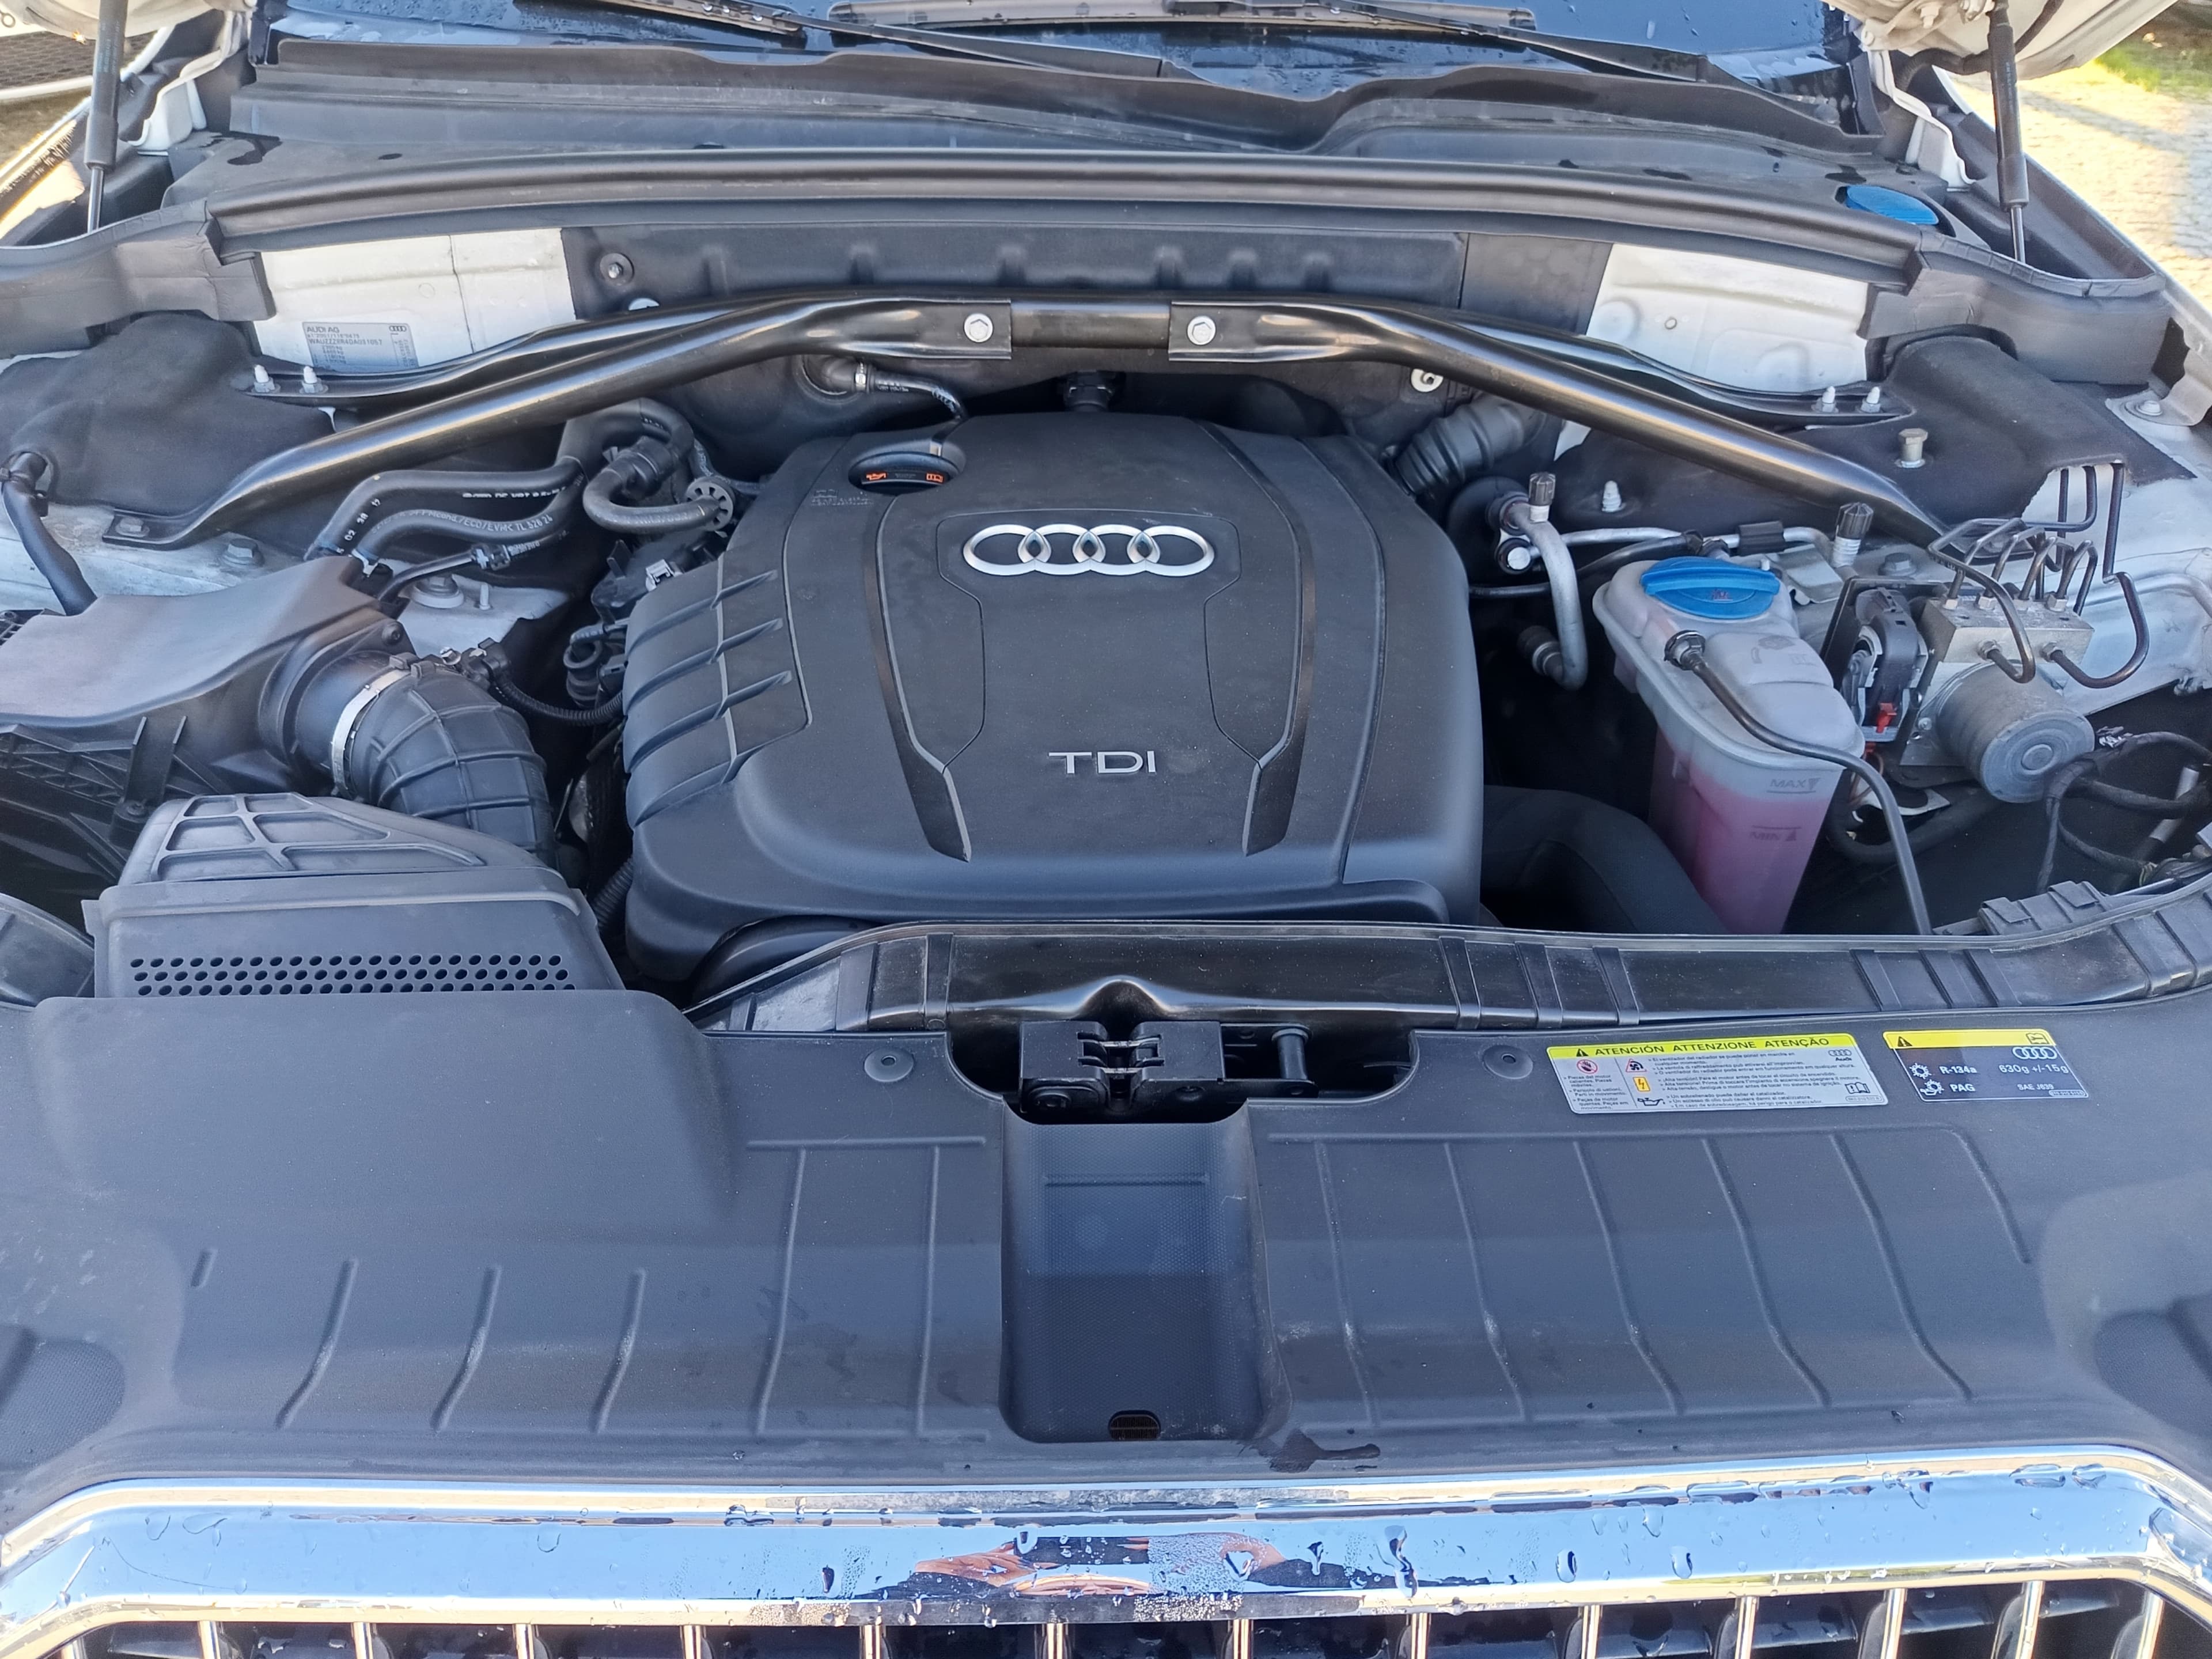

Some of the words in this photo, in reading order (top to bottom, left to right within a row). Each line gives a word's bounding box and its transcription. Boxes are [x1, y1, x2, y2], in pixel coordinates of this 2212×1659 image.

[1048, 750, 1157, 774] TDI
[1769, 778, 1806, 789] MAX
[1595, 1045, 1664, 1055] ATENCIÓN
[1672, 1041, 1756, 1051] ATTENZIONE
[1765, 1037, 1829, 1048] ATENÇÃO
[1938, 1065, 1978, 1074] R-134a
[1998, 1064, 2030, 1075] 630g
[2032, 1063, 2070, 1075] +/-15g
[1949, 1084, 1976, 1092] PAG
